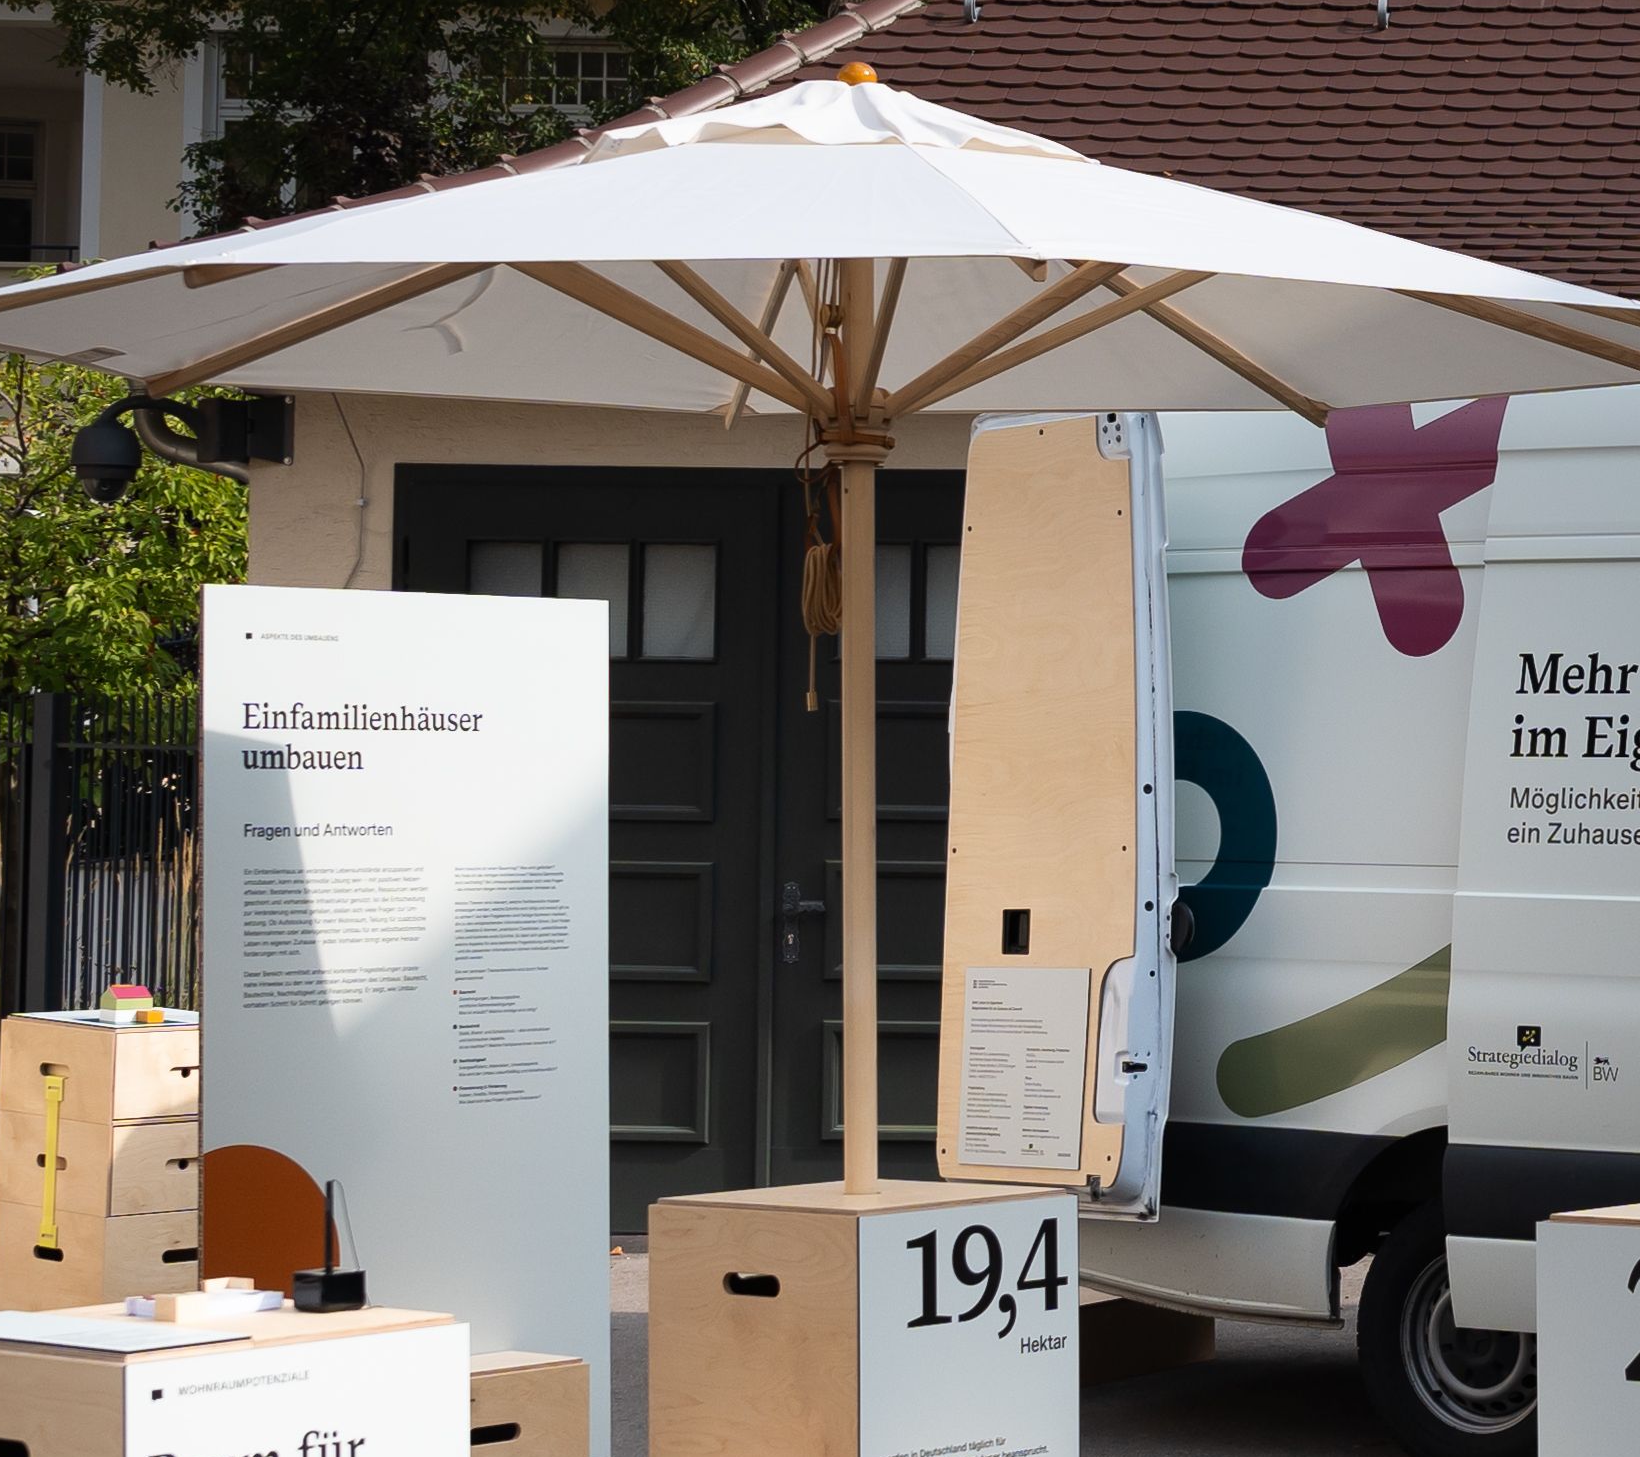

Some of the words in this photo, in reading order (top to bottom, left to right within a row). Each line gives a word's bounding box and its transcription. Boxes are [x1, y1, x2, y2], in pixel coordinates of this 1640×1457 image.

[1515, 652, 1639, 694] Mehr
[242, 701, 483, 732] Einfamilienhäuser
[1509, 714, 1568, 758] im
[241, 743, 364, 770] umbauen
[243, 823, 291, 841] Fragen
[294, 823, 320, 837] und
[323, 823, 393, 836] Antworten
[1507, 821, 1540, 844] ein
[1467, 1046, 1578, 1072] Strategiedialog
[1592, 1065, 1619, 1082] BW
[906, 1217, 1068, 1339] 19,4
[1020, 1334, 1067, 1354] Hektar
[177, 1370, 310, 1396] WOHNRAUMPOTENZIALE
